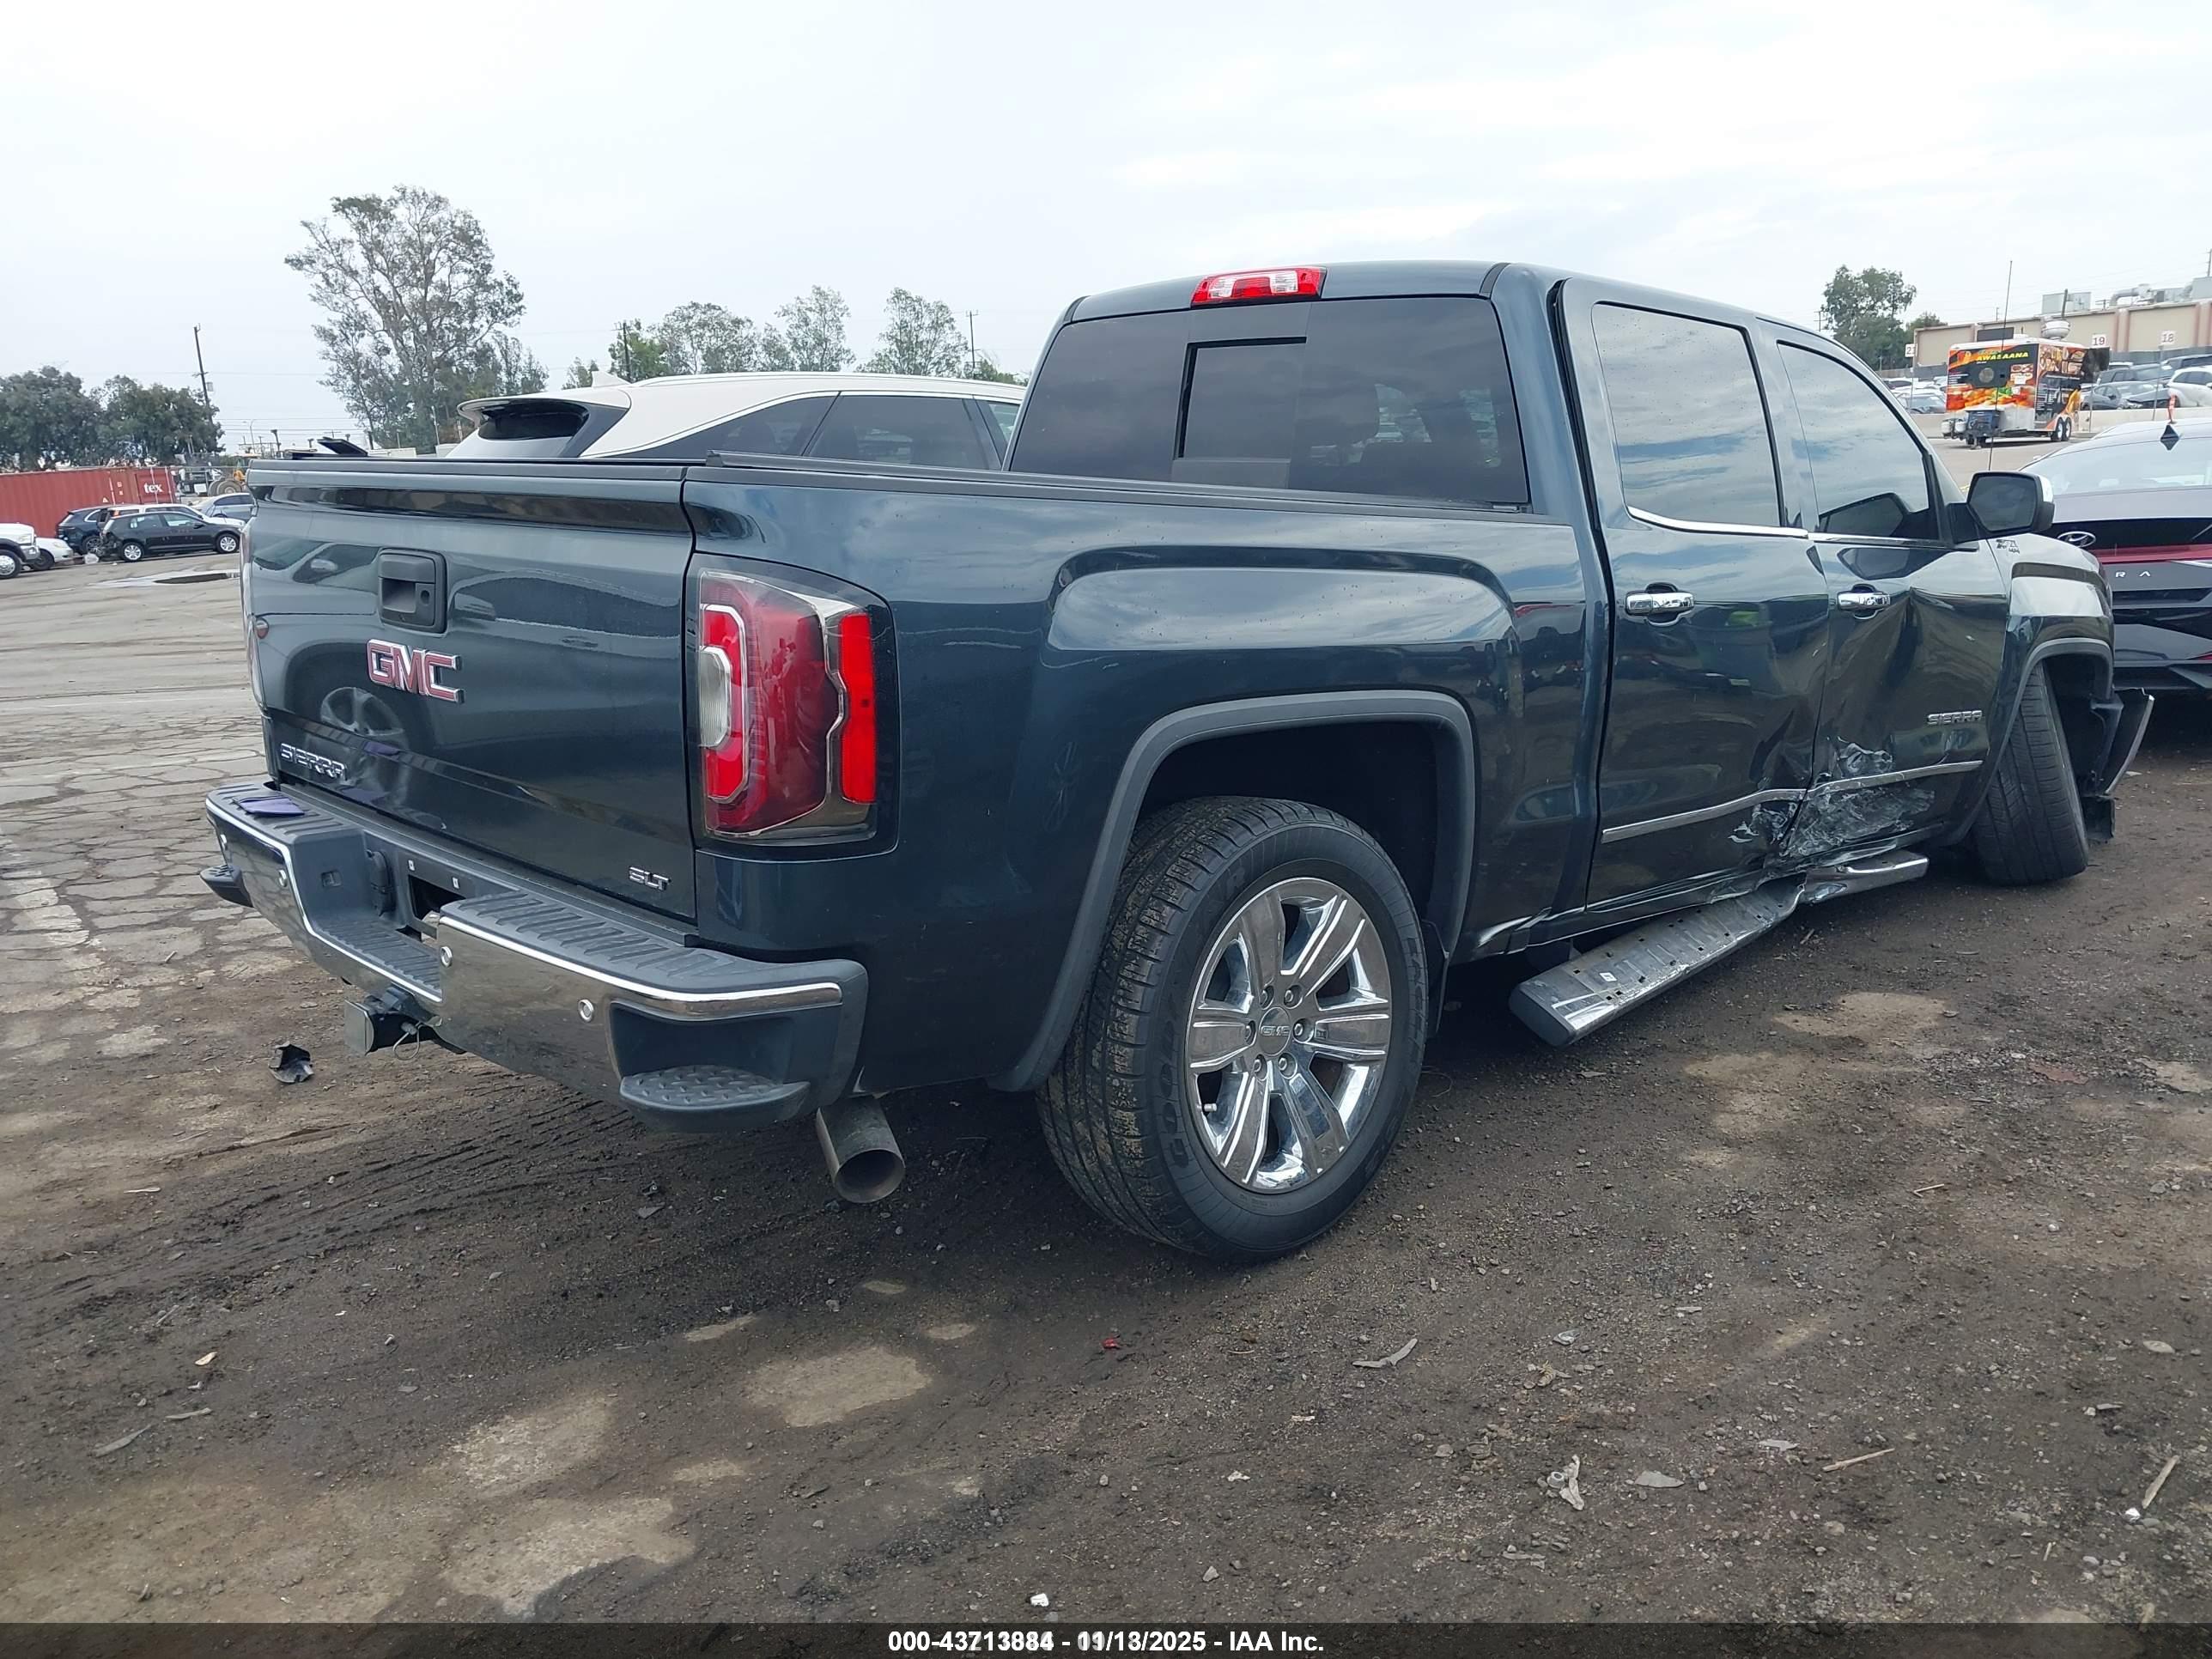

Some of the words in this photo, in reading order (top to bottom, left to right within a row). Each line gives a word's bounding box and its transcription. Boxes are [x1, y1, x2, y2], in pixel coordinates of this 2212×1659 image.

[2093, 336, 2106, 346] 19
[143, 483, 164, 494] tex
[366, 638, 465, 704] GMC
[1927, 709, 1983, 726] SIERRA
[280, 742, 349, 781] SIERRA
[628, 865, 672, 890] SLT
[1261, 1025, 1290, 1036] GMC
